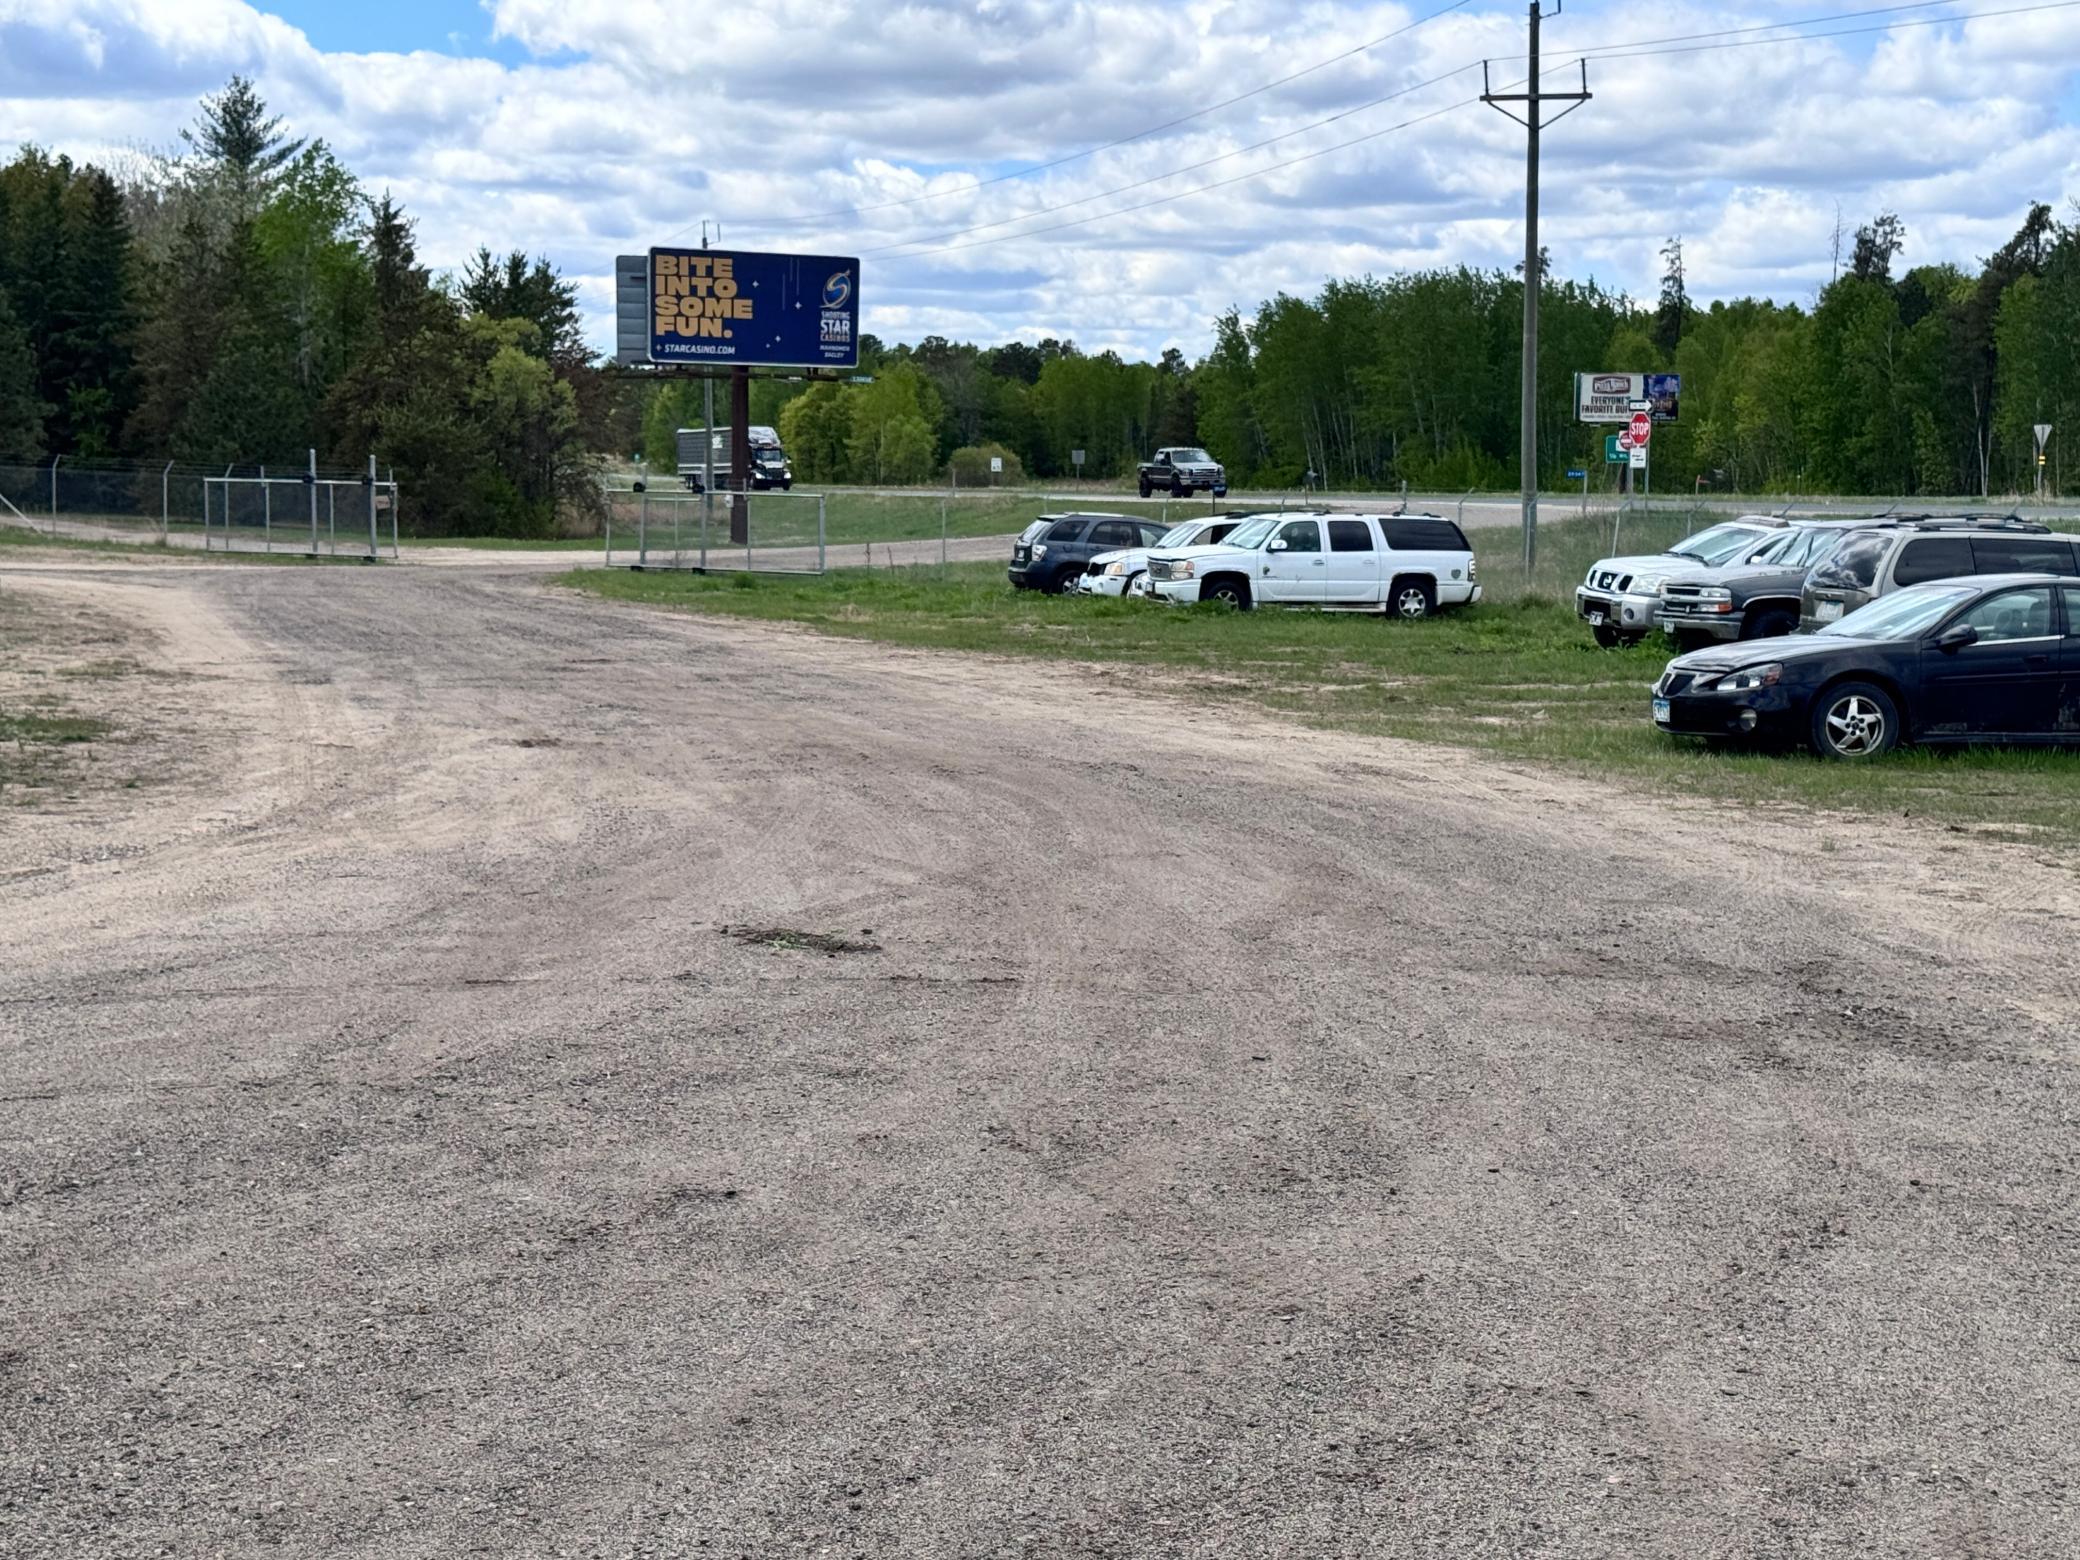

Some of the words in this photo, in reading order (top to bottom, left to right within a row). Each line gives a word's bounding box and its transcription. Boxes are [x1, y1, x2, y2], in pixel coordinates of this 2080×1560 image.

[655, 254, 733, 278] BITE
[655, 275, 738, 298] INTO
[655, 295, 753, 319] SOME
[655, 316, 733, 338] FUN.
[820, 320, 850, 334] STAR
[664, 344, 736, 355] STARCASINO.COM
[1582, 405, 1613, 414] FAVORITE
[1631, 423, 1649, 435] STOP
